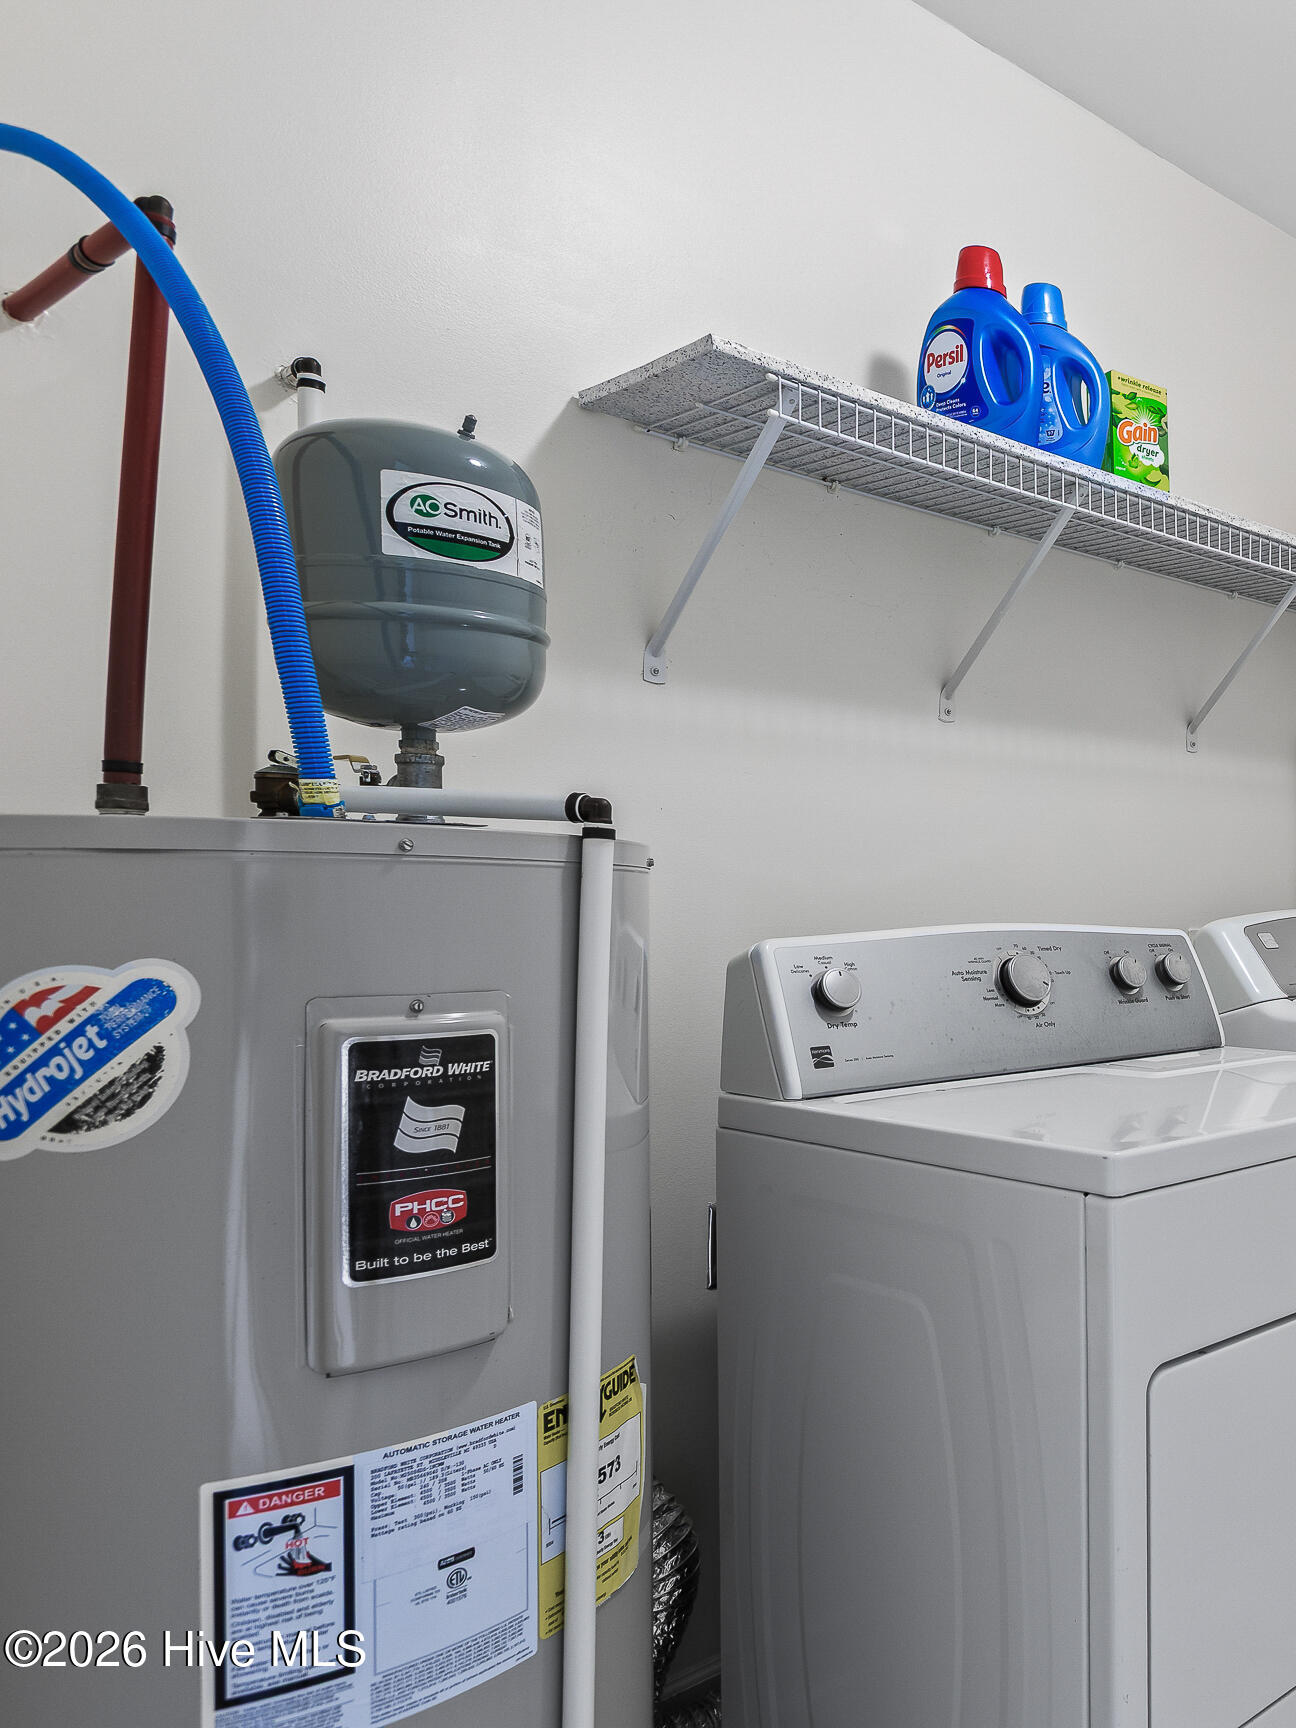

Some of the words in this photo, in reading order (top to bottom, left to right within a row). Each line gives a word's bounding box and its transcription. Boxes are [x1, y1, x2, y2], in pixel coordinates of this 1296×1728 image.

[927, 343, 964, 374] Persil
[1121, 377, 1142, 388] wrinkle
[1118, 420, 1158, 444] Gain
[1136, 444, 1160, 458] dryer
[407, 526, 434, 536] Potable
[435, 529, 456, 539] Water
[456, 534, 488, 545] Expansion
[487, 541, 501, 549] Tank
[354, 1066, 444, 1082] BRADFORD
[447, 1061, 492, 1075] WHITE
[366, 1074, 482, 1090] CORPORATION
[433, 1123, 450, 1132] 1881
[395, 1194, 465, 1217] PHCC
[394, 1235, 421, 1246] OFFICIAL
[421, 1232, 442, 1242] WATER
[442, 1228, 464, 1237] HEATER
[355, 1258, 390, 1271] Built
[393, 1255, 409, 1266] to
[413, 1251, 432, 1263] be
[435, 1247, 458, 1259] the
[383, 1441, 430, 1459] AUTOMATIC
[432, 1429, 469, 1446] STORAGE
[469, 1421, 494, 1434] WATER
[494, 1411, 520, 1426] HEATER
[258, 1486, 325, 1510] DANGER
[285, 1537, 310, 1550] HOT
